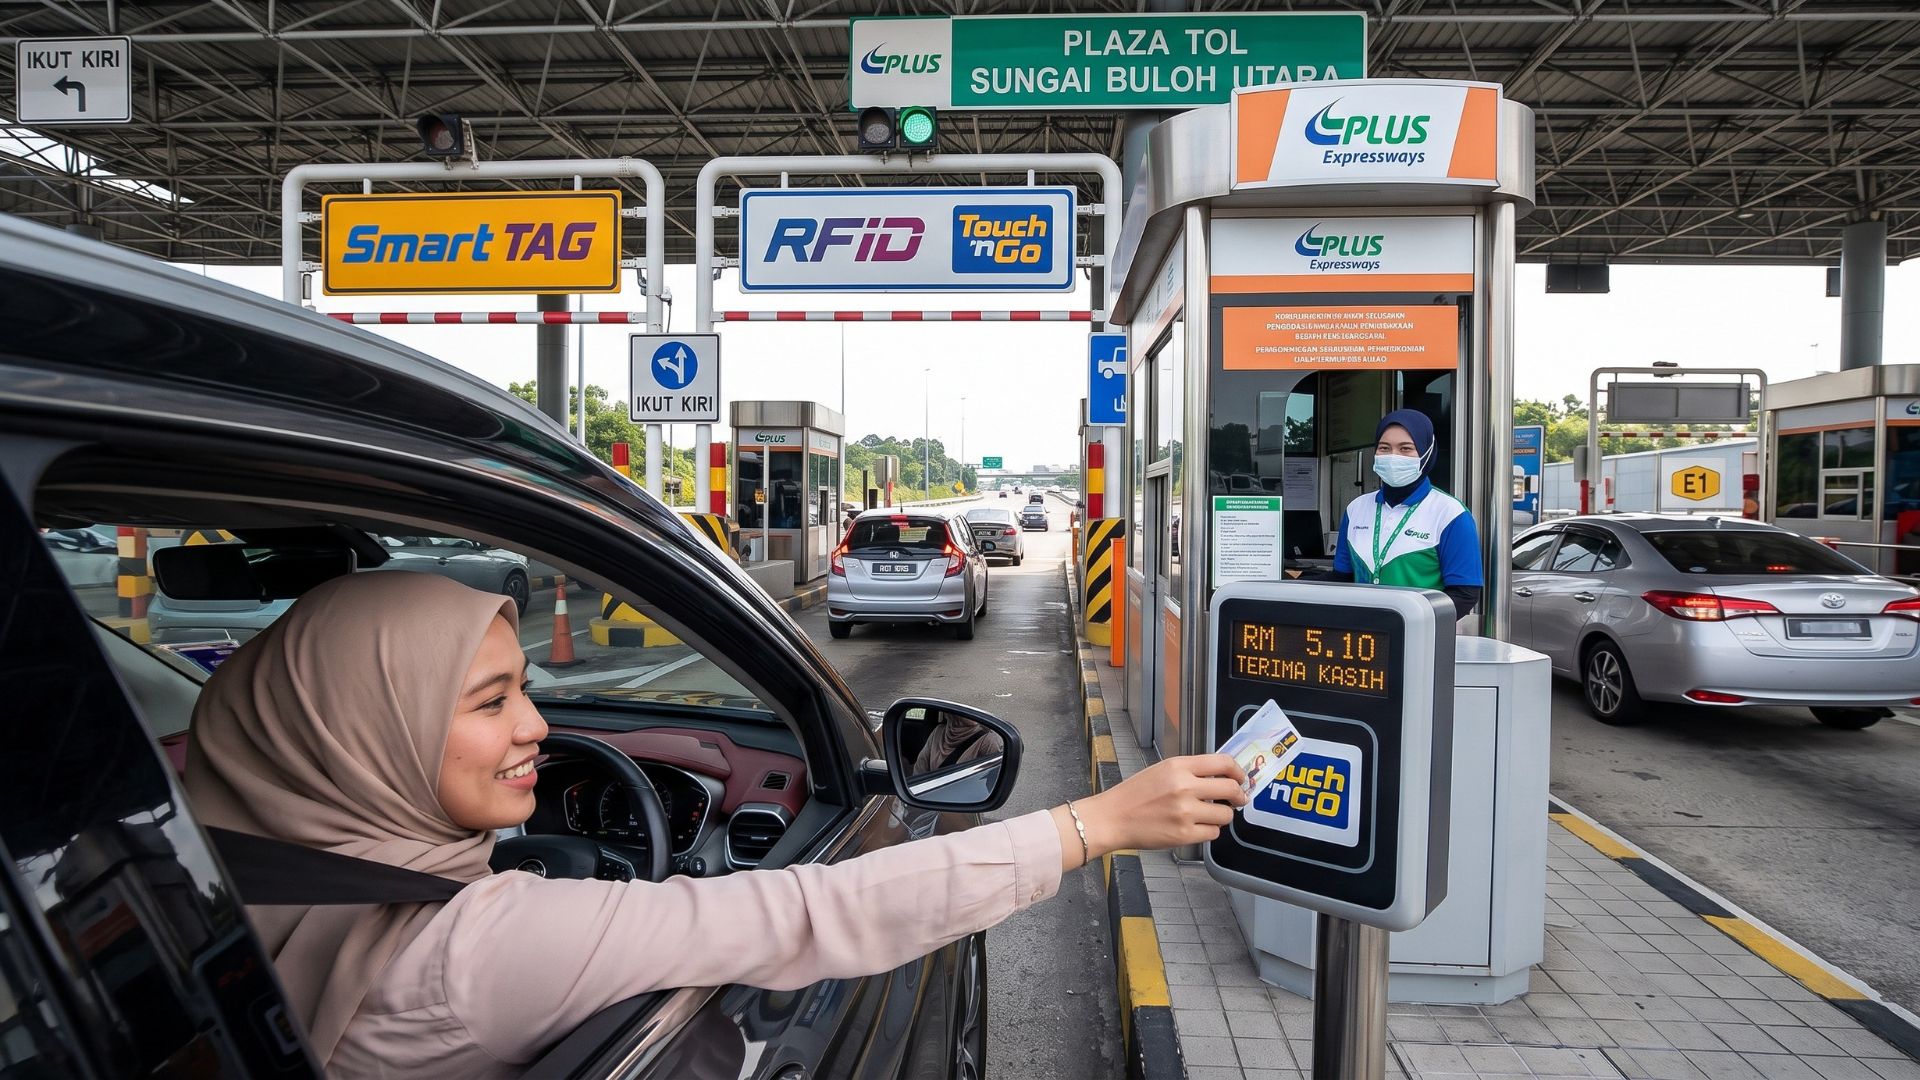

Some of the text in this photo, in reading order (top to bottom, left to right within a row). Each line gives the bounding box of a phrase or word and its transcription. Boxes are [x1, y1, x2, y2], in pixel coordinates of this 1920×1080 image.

[1064, 29, 1248, 56] PLAZA TOL
[27, 49, 120, 69] IKUT KIRI
[883, 53, 942, 74] PLUS
[971, 66, 1091, 93] SUNGAI
[1107, 66, 1216, 93] BULOH
[1341, 114, 1431, 145] PLUS
[1323, 150, 1426, 167] Expressways
[959, 214, 1047, 238] Touch
[342, 222, 597, 264] Smart TAG
[1320, 234, 1384, 257] PLUS
[1309, 260, 1381, 272] Expressways
[637, 396, 713, 412] IKUT KIRI
[764, 435, 786, 443] PLUS
[1683, 474, 1708, 494] E1
[1412, 531, 1430, 540] PLUS
[1243, 625, 1376, 662] RM 5.10
[1236, 654, 1385, 691] TERIMA KASIH
[1275, 764, 1345, 792] uch
